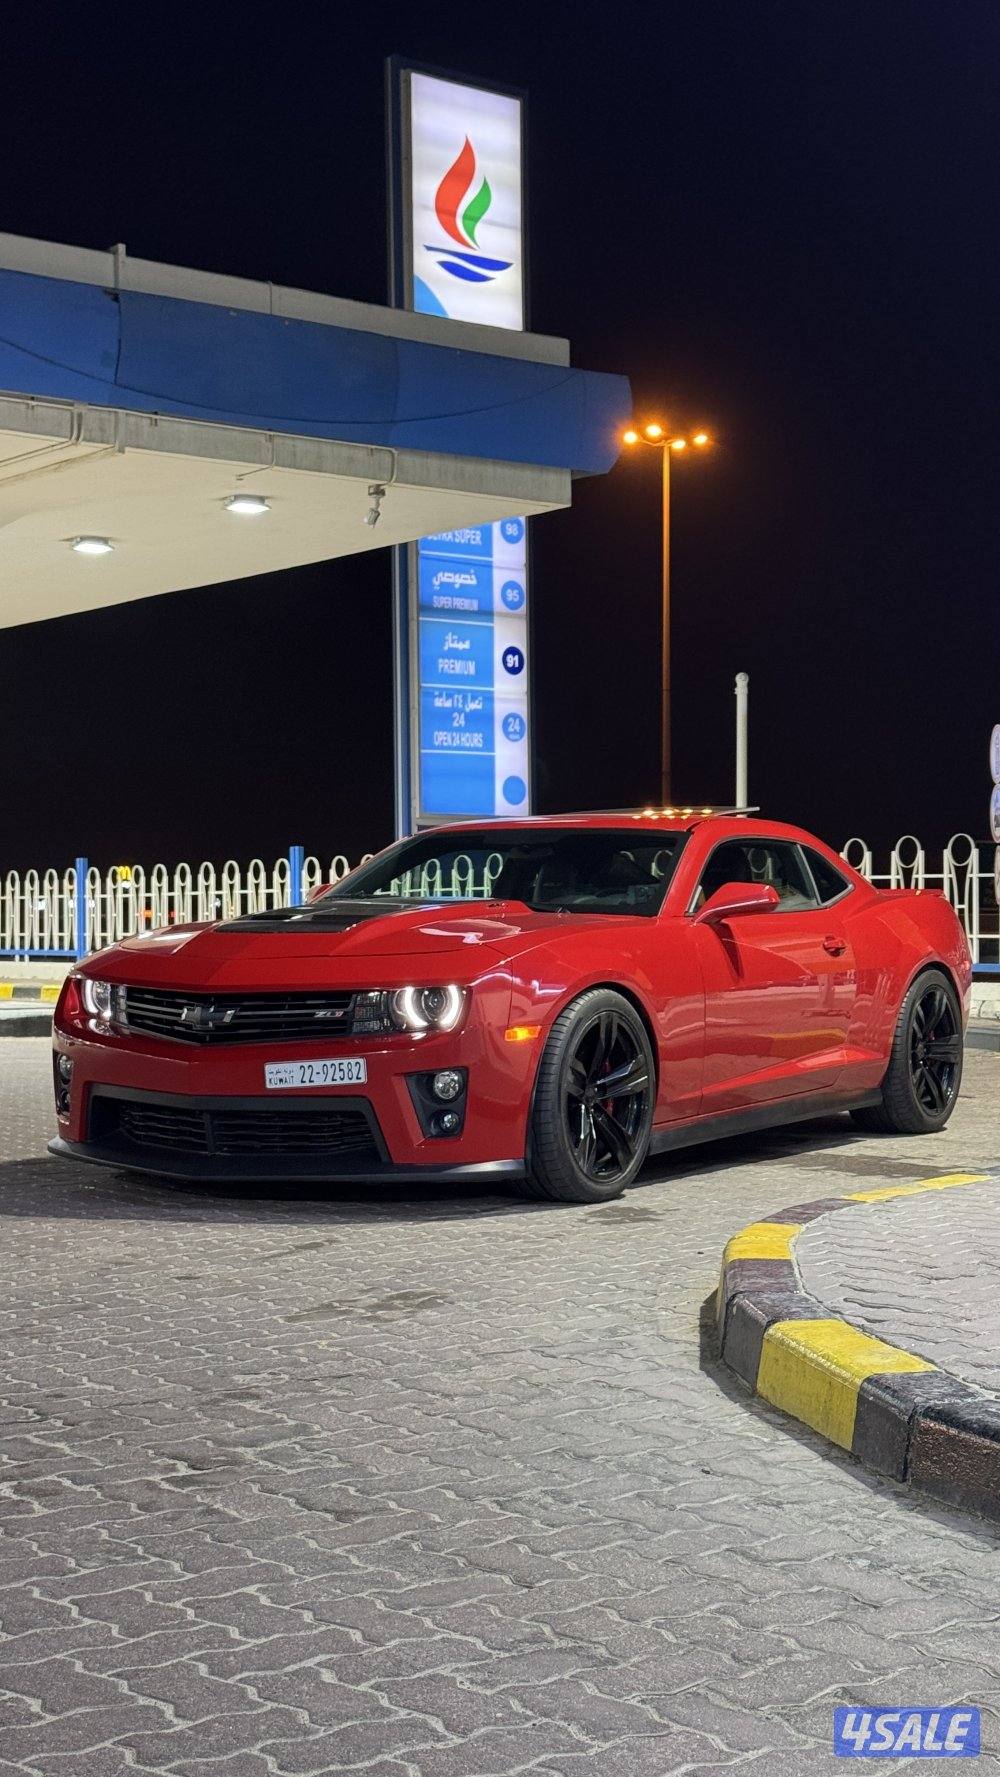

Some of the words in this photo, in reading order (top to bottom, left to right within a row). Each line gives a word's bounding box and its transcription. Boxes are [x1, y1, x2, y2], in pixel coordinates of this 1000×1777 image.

[454, 529, 481, 545] SUPER
[432, 569, 477, 591] خصوصي
[433, 595, 452, 609] SUPER
[506, 589, 519, 602] 95
[443, 632, 470, 650] ممتاز
[438, 658, 475, 675] PREMIUM
[506, 654, 519, 667] 91
[452, 712, 465, 727] 24
[508, 717, 520, 732] 24
[434, 731, 452, 746] OPEN
[461, 732, 482, 748] HOURS
[300, 1061, 361, 1083] 22-92582
[269, 1076, 294, 1085] KUWAIT
